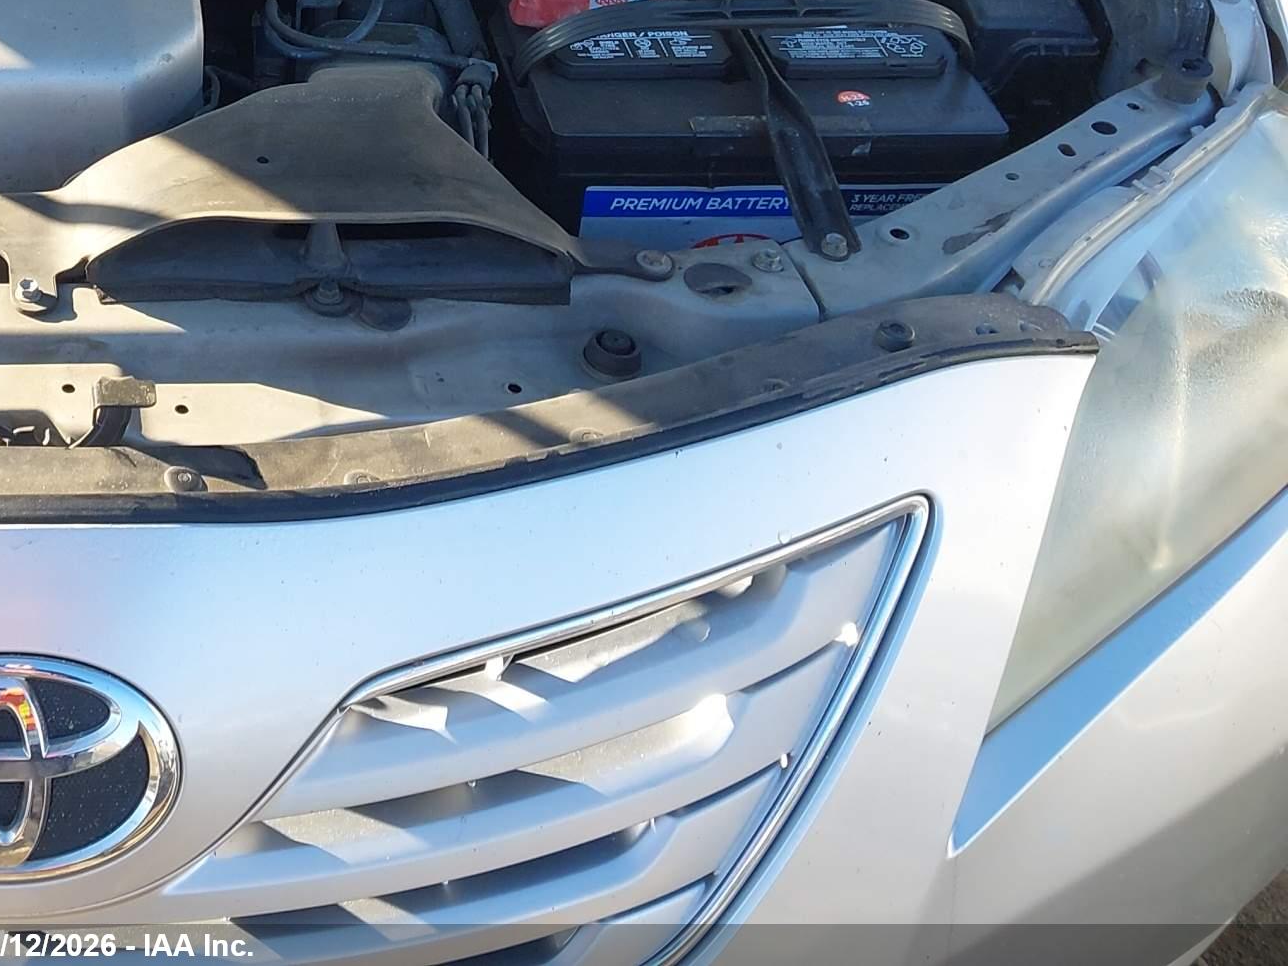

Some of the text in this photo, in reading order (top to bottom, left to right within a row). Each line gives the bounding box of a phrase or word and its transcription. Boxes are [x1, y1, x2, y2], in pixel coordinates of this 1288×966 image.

[610, 197, 790, 210] PREMIUM BATTERY
[862, 194, 896, 203] YEAR
